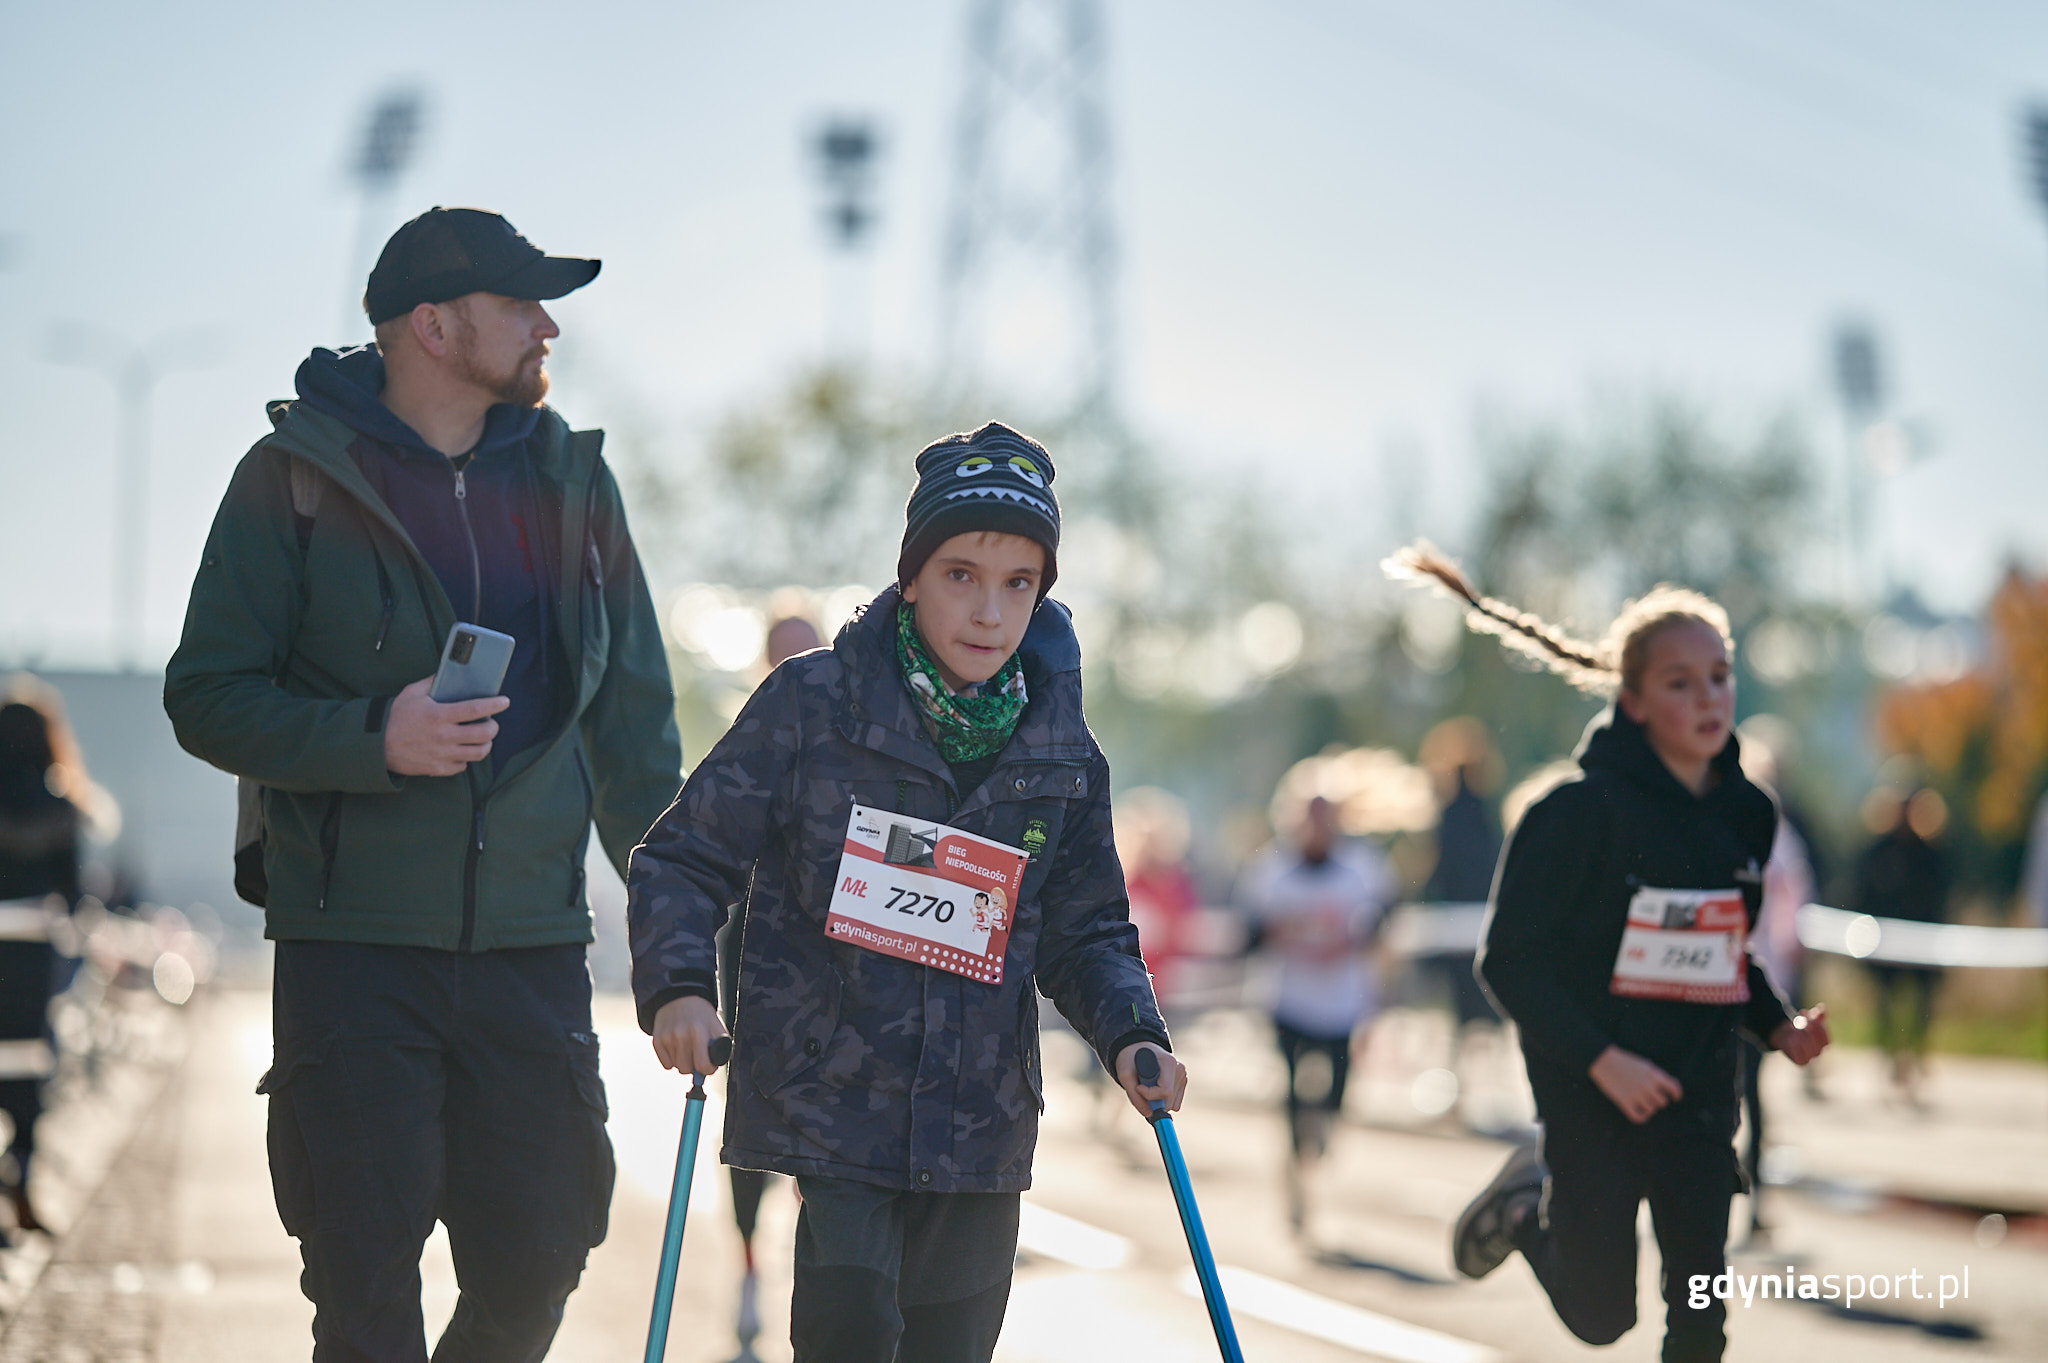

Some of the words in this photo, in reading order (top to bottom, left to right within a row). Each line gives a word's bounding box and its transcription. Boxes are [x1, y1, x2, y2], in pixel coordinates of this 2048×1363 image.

[947, 844, 967, 858] BIEG
[945, 856, 1007, 884] NIEPODLEGŁOŚCI
[840, 876, 869, 899] MŁ
[884, 886, 955, 923] 7270
[832, 920, 917, 954] gdyniasport.pl
